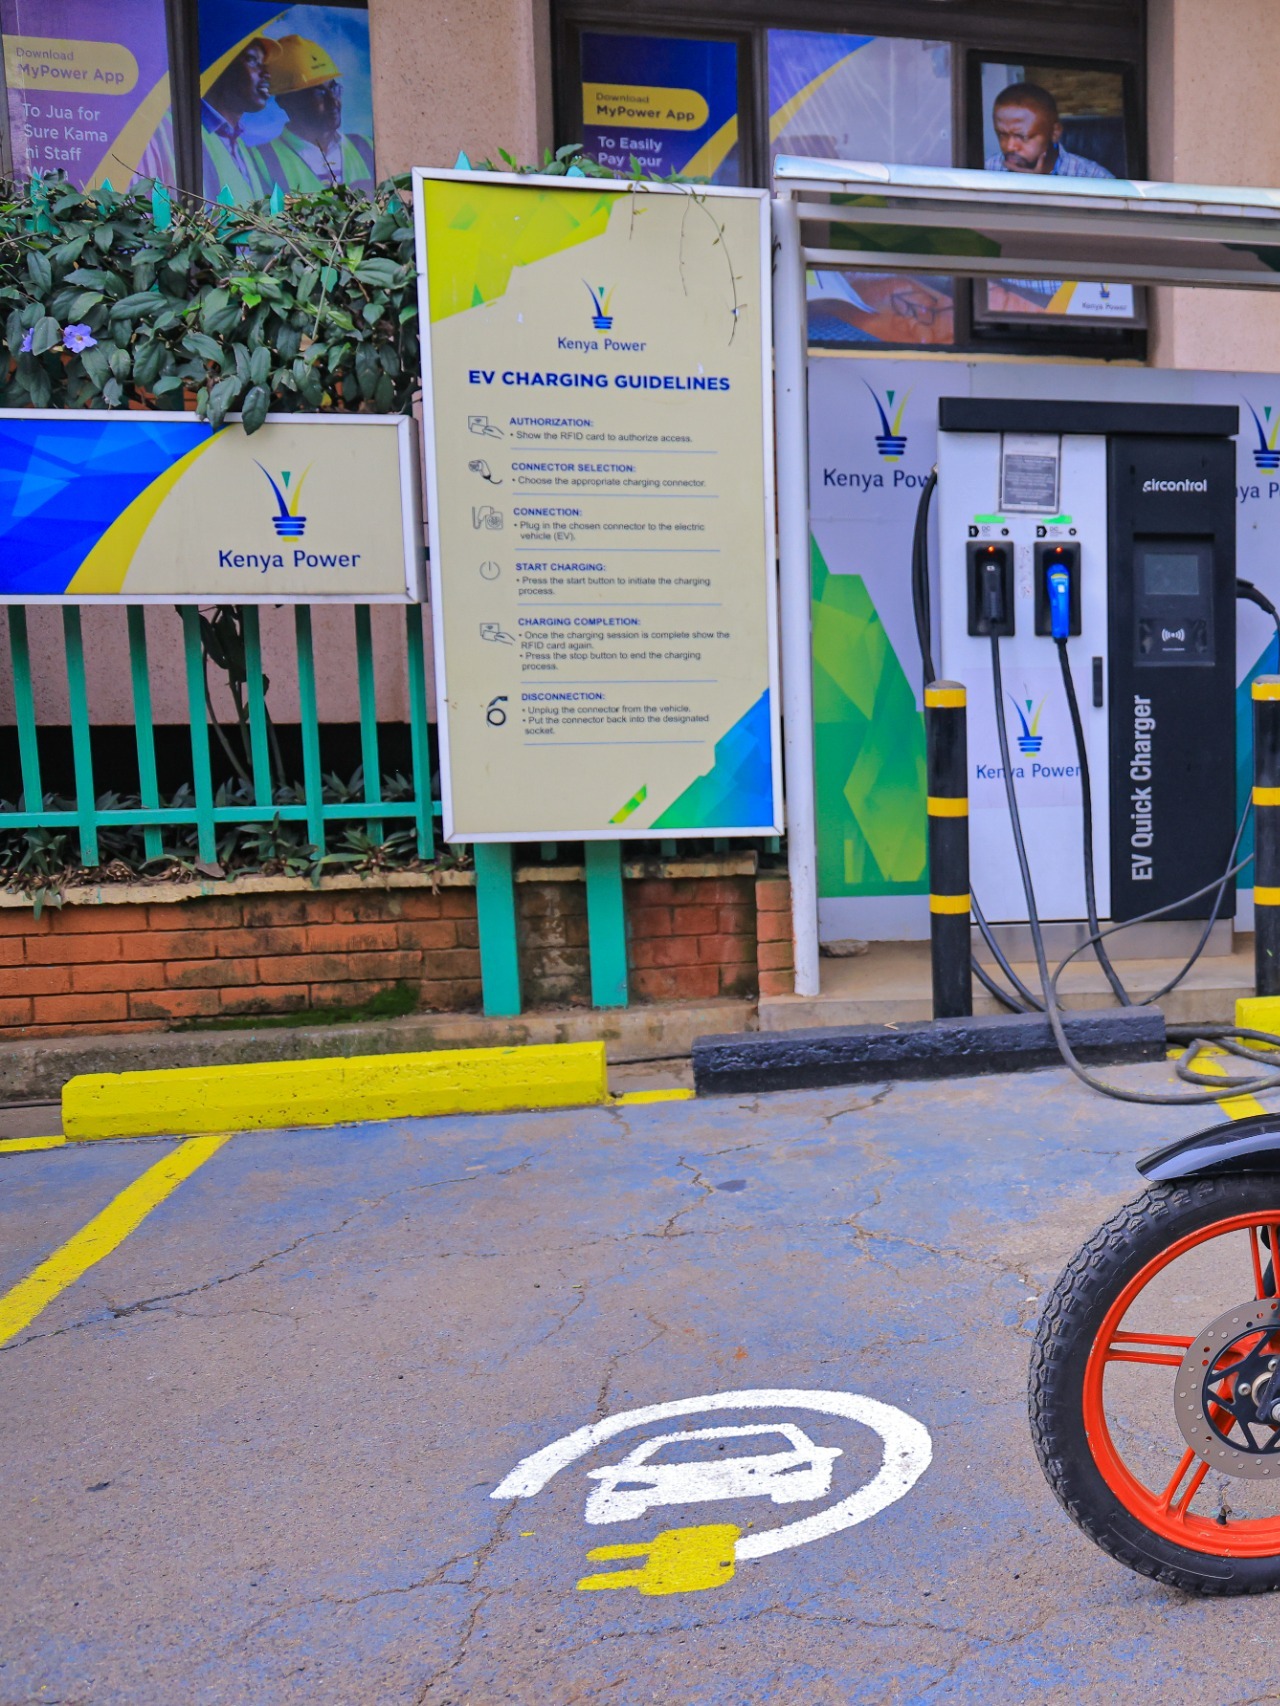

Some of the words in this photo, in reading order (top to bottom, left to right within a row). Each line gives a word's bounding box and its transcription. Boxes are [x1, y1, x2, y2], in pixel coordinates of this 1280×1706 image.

[16, 47, 74, 60] Download
[18, 63, 87, 79] MyPower
[94, 68, 124, 84] App
[596, 93, 649, 103] Download
[22, 103, 40, 117] To
[46, 105, 73, 119] Jua
[78, 107, 100, 121] for
[597, 105, 660, 118] MyPower
[667, 109, 694, 122] App
[24, 124, 59, 139] Sure
[64, 126, 108, 142] Kama
[598, 136, 615, 148] To
[620, 137, 662, 153] Easily
[26, 145, 39, 159] ni
[45, 146, 81, 161] Staff
[598, 153, 625, 166] Pay
[635, 156, 662, 167] our
[557, 337, 599, 353] Kenya
[604, 339, 646, 352] Power
[468, 370, 495, 384] EV
[501, 371, 608, 388] CHARGING
[614, 374, 730, 391] GUIDELINES
[509, 417, 594, 427] AUTHORIZATION:
[516, 431, 541, 439] Show
[543, 432, 558, 440] the
[560, 432, 583, 440] RFID
[585, 433, 605, 441] card
[618, 434, 658, 442] authorize
[511, 462, 575, 471] CONNECTOR
[577, 463, 636, 472] SELECTION:
[518, 476, 552, 485] Choose
[554, 476, 569, 485] the
[571, 477, 620, 486] appropriate
[623, 478, 660, 488] charging
[824, 468, 884, 493] Kenya
[513, 507, 582, 516] CONNECTION:
[520, 521, 540, 531] Plug
[553, 522, 566, 530] the
[569, 522, 600, 530] chosen
[603, 523, 645, 531] connector
[648, 523, 656, 531] to
[658, 523, 672, 531] the
[674, 523, 705, 531] electric
[520, 532, 551, 540] vehicle
[218, 550, 284, 573] Kenya
[293, 550, 361, 568] Power
[515, 563, 547, 571] START
[550, 563, 606, 571] CHARGING:
[522, 576, 548, 584] Press
[588, 577, 615, 585] button
[628, 577, 656, 585] initiate
[658, 577, 672, 585] the
[674, 577, 711, 586] charging
[518, 618, 571, 626] CHARGING
[574, 617, 640, 626] COMPLETION:
[524, 631, 548, 639] Once
[551, 631, 564, 639] the
[567, 632, 604, 640] charging
[607, 631, 639, 639] session
[641, 631, 648, 639] is
[651, 631, 689, 640] complete
[692, 631, 714, 639] show
[716, 631, 730, 639] the
[521, 641, 544, 649] RFID
[525, 652, 550, 660] Press
[553, 652, 567, 660] the
[570, 652, 588, 661] stop
[664, 652, 701, 661] charging
[521, 692, 605, 701] DISCONNECTION:
[528, 706, 559, 715] Unplug
[622, 705, 641, 713] from
[644, 705, 657, 713] the
[528, 716, 543, 724] Put
[562, 716, 604, 724] connector
[647, 715, 661, 723] the
[663, 714, 709, 724] designated
[1130, 694, 1156, 781] Charger
[1131, 786, 1154, 848] Quick
[1131, 853, 1153, 881] EV
